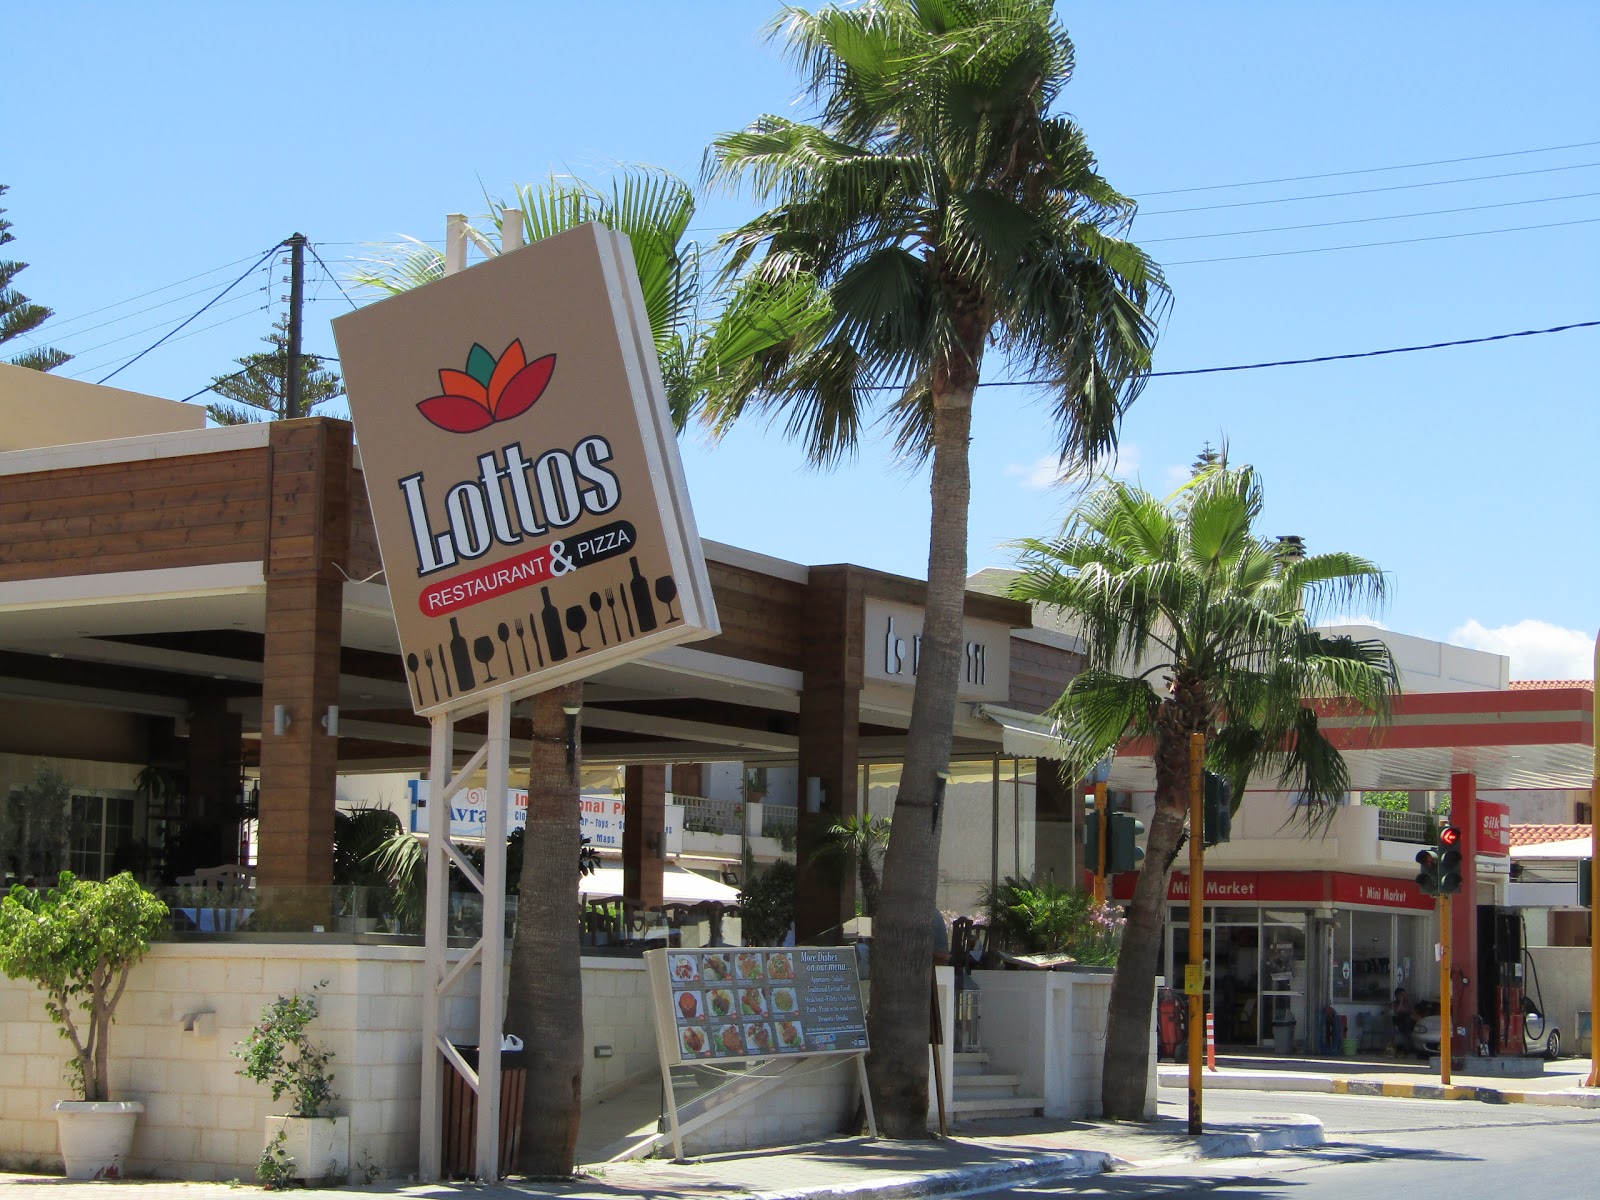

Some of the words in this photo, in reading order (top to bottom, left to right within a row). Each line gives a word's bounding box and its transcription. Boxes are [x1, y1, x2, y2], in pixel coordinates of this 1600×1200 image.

[398, 434, 621, 578] Lottos
[427, 556, 545, 610] RESTAURANT
[548, 540, 577, 577] &
[577, 529, 631, 559] PIZZA
[1483, 816, 1500, 830] Silk
[596, 834, 615, 844] Maps
[1206, 881, 1254, 895] Market
[1366, 886, 1381, 900] Mini
[1383, 888, 1407, 902] Market
[800, 952, 817, 963] More
[818, 951, 838, 962] Dishes
[806, 964, 815, 972] on
